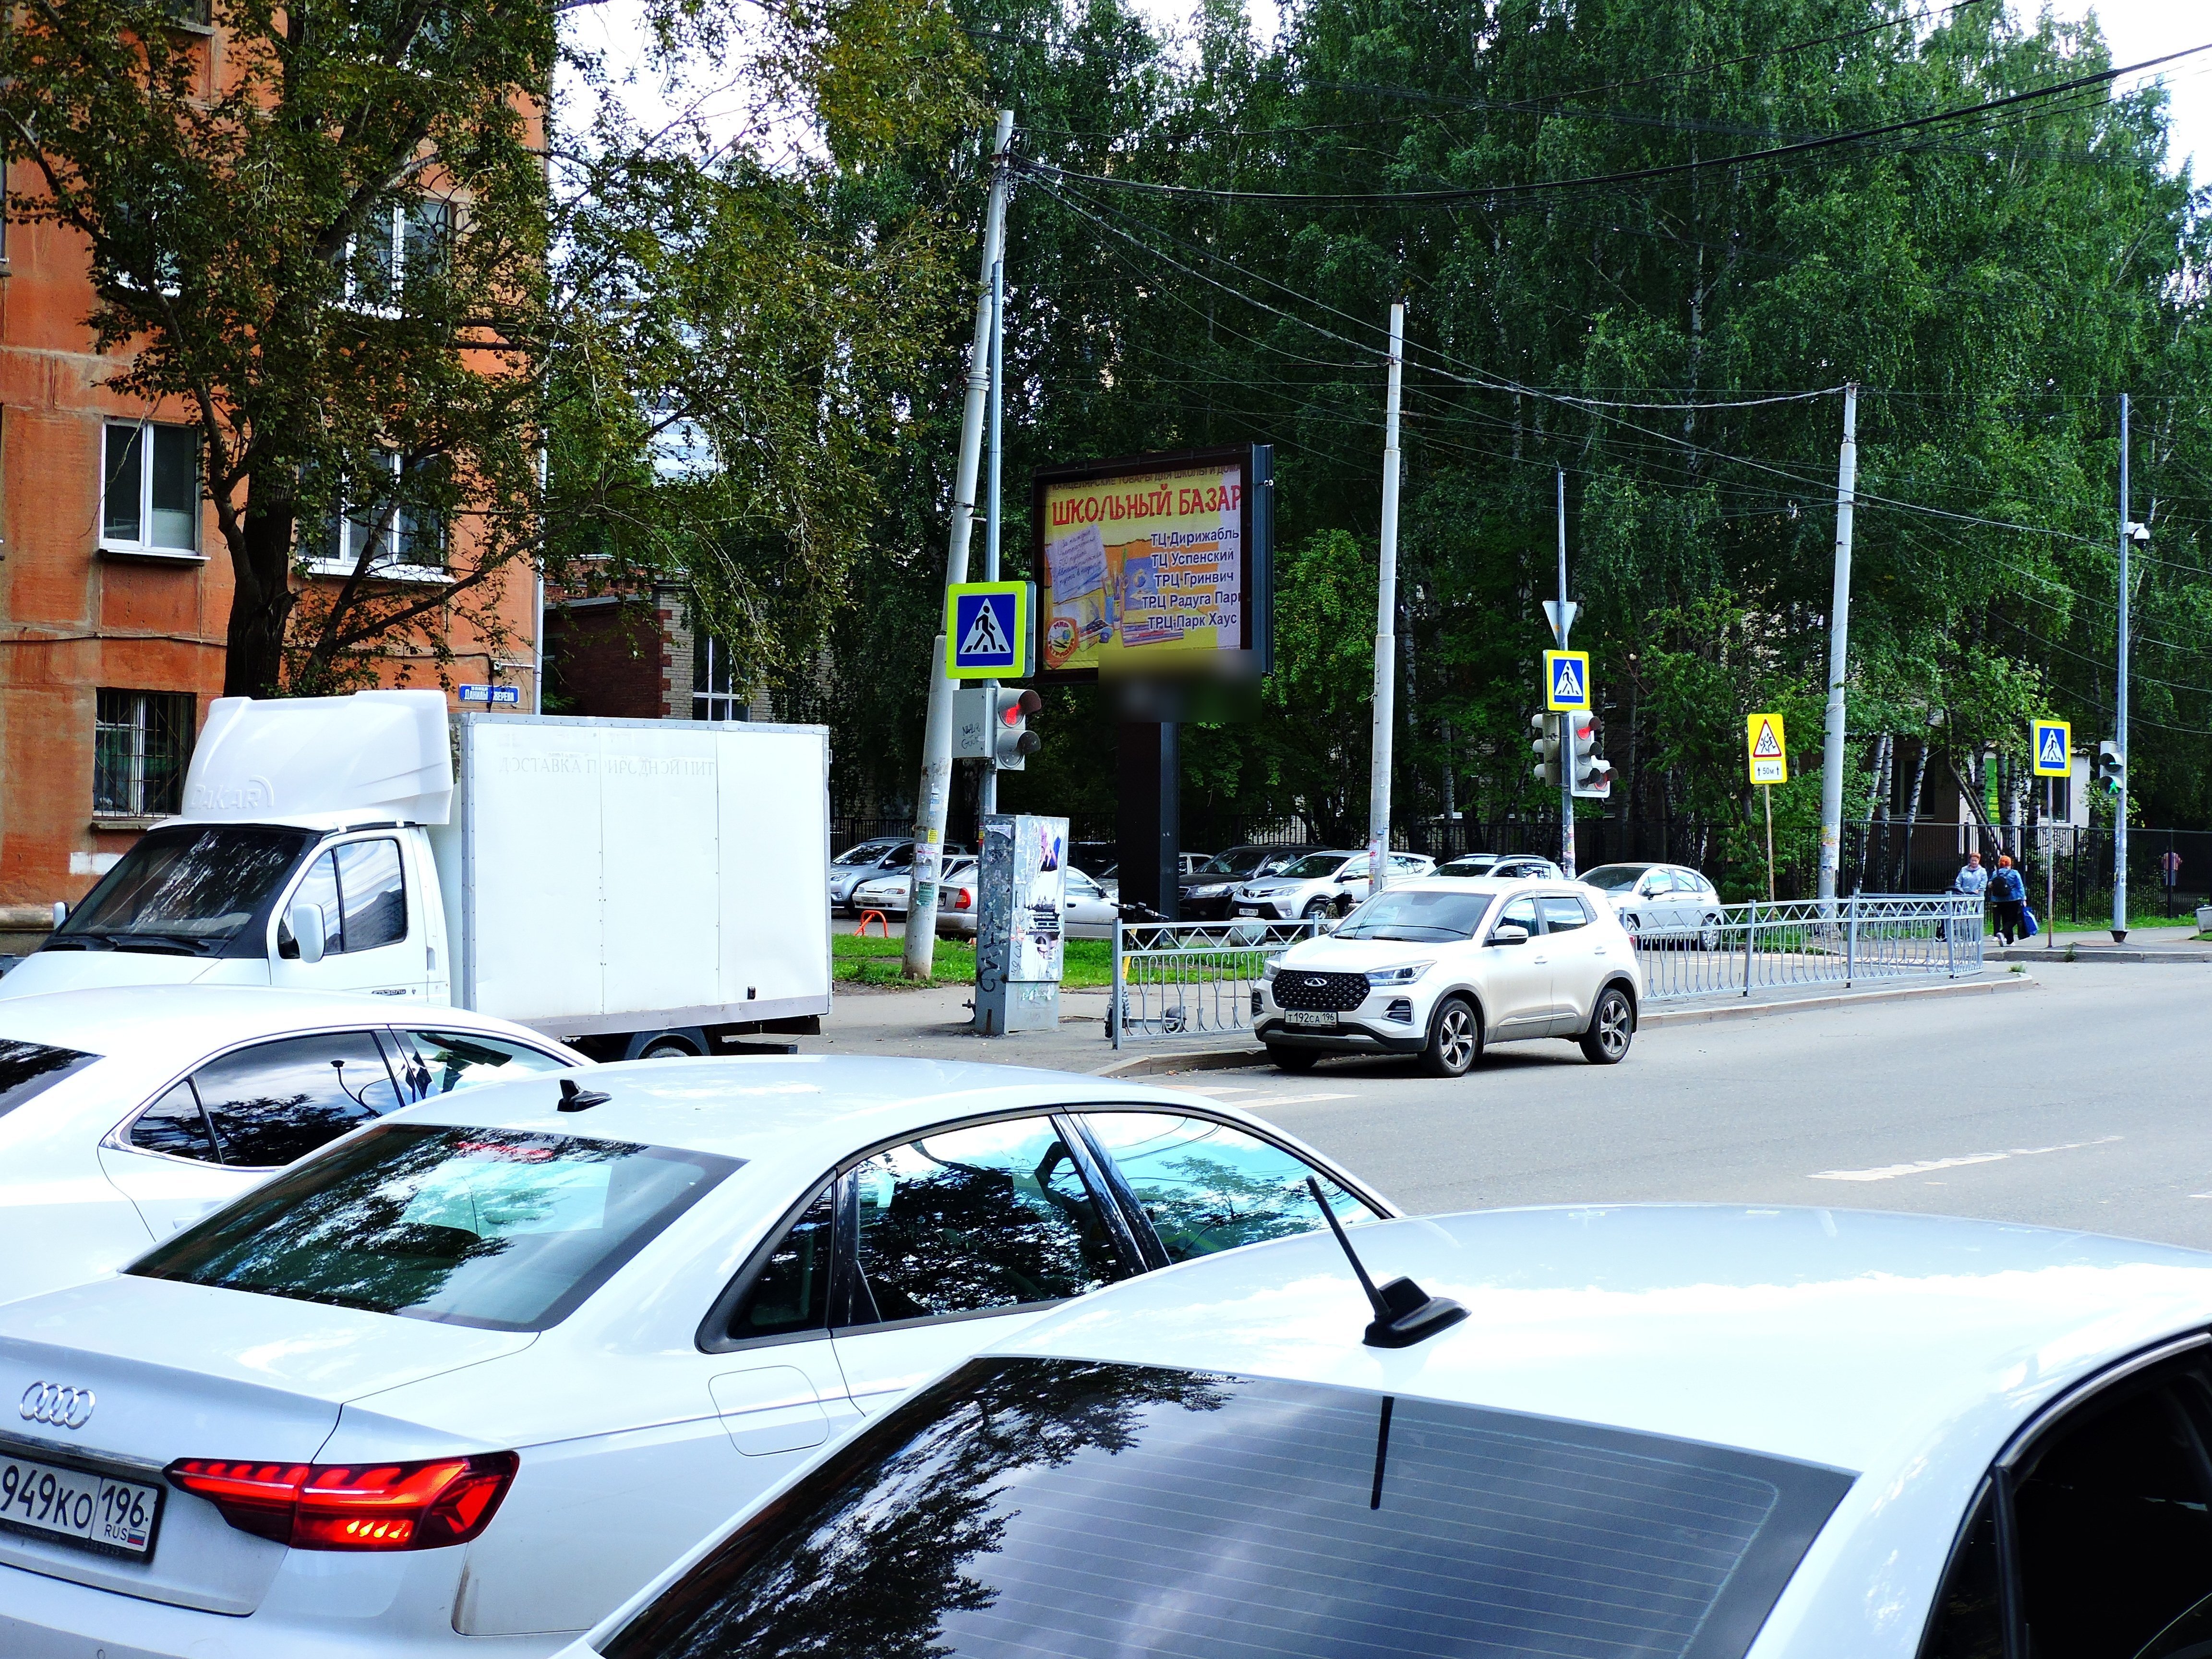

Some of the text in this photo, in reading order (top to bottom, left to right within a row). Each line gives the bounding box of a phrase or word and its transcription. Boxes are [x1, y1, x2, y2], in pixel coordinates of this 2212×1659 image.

[1154, 471, 1172, 481] ДЛЯ
[1175, 468, 1207, 479] ШКОЛЫ
[1052, 483, 1241, 526] ШКОЛЬНЫЙ БАЗАР
[1151, 527, 1239, 546] ТЦ Дирижабль
[1152, 548, 1234, 568] ТЦ Успенский
[1155, 572, 1234, 588] ТРЦ Гринвич
[1142, 595, 1166, 610] ТРЦ
[1170, 594, 1211, 609] Радуга
[1148, 612, 1237, 630] ТРЦ Парк Хаус
[499, 757, 582, 774] ДОСТАВКА
[102, 1485, 145, 1527] 196
[104, 1524, 127, 1540] RUS
